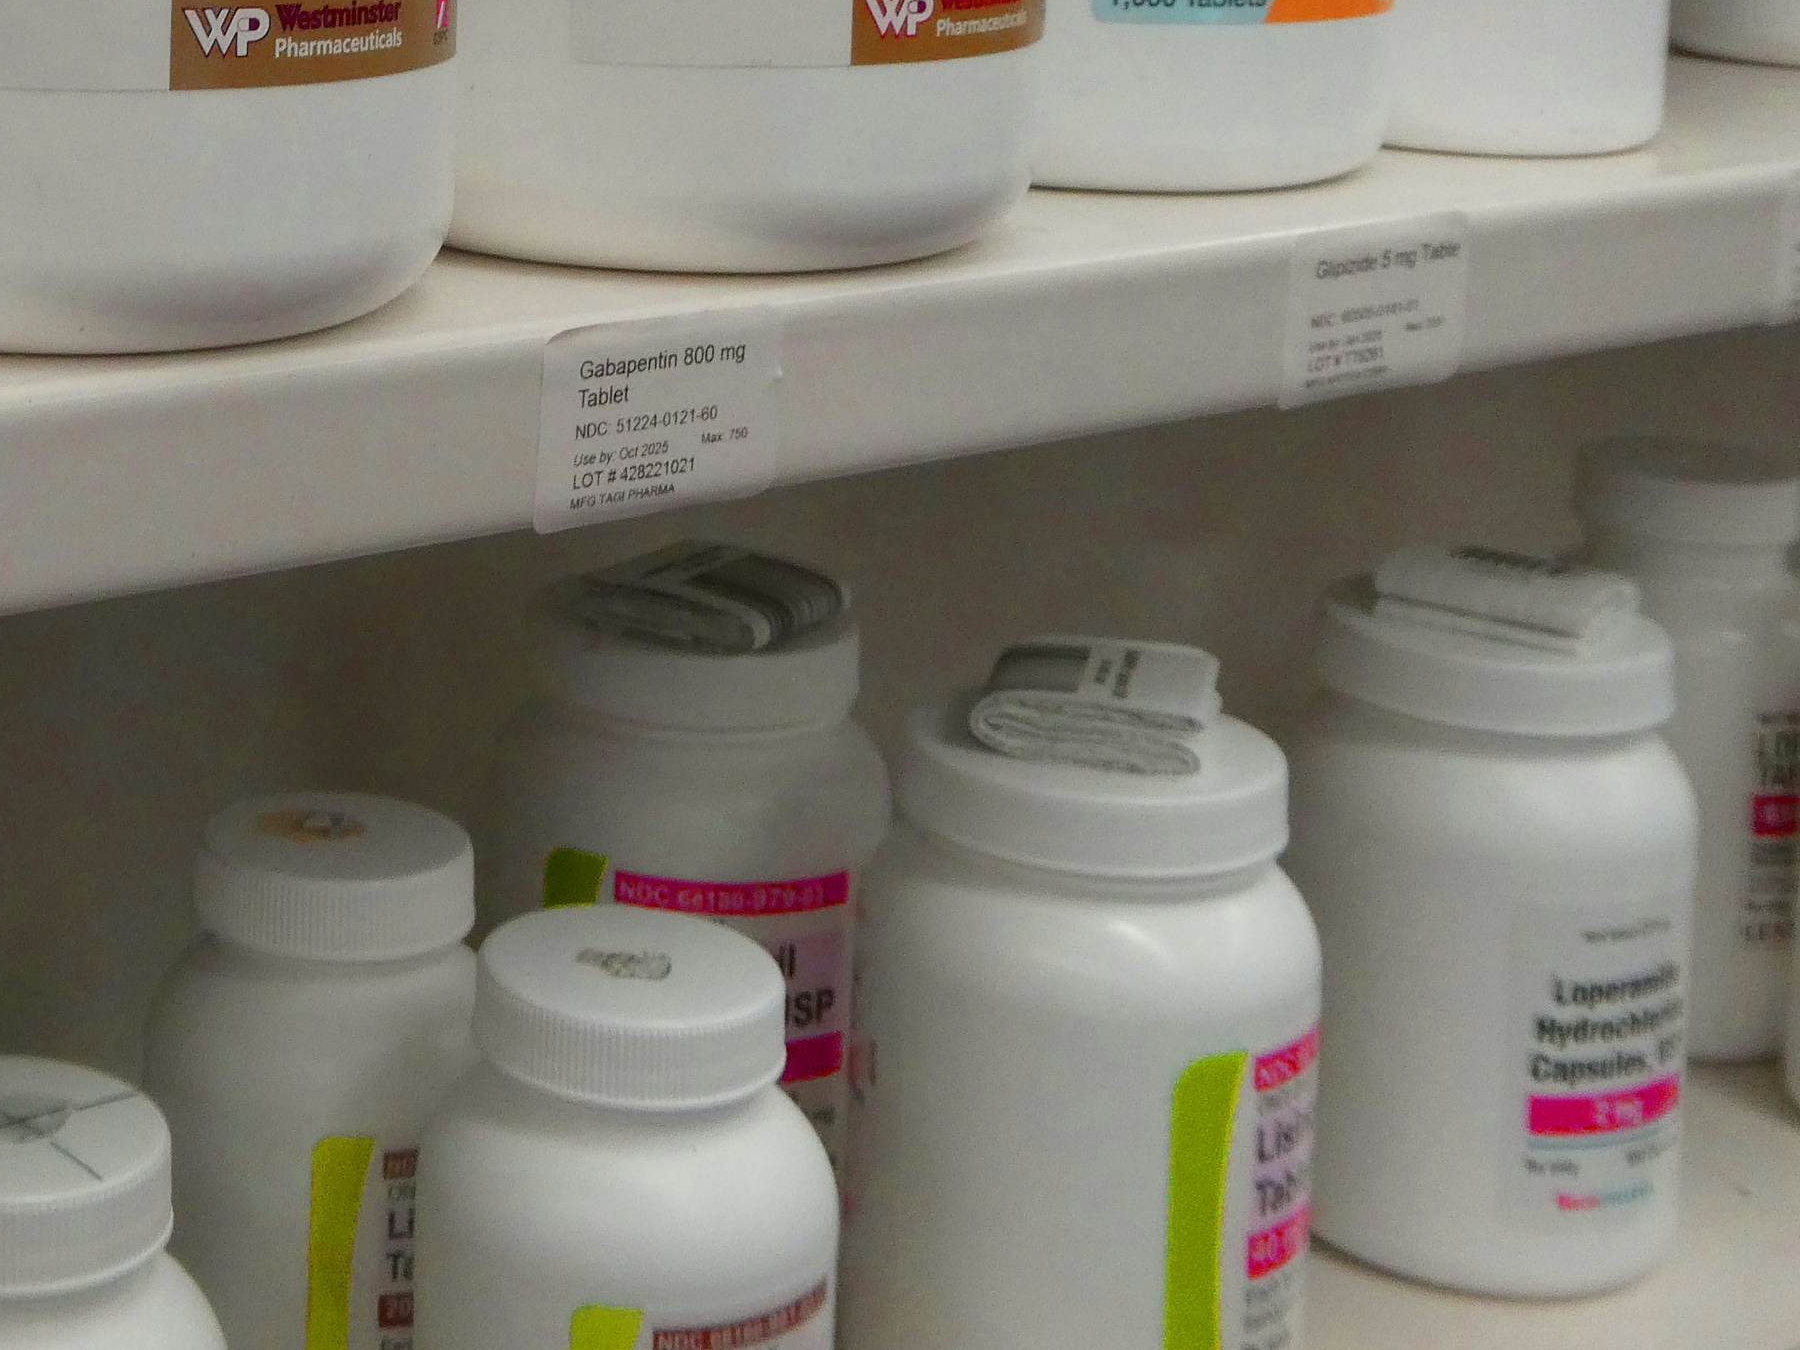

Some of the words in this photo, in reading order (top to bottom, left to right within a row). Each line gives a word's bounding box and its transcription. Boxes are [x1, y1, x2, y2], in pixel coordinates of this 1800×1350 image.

[181, 5, 272, 59] WP
[274, 0, 402, 32] Westminster
[273, 27, 403, 60] Pharmaceuticals
[579, 349, 678, 380] Gabapentin
[683, 343, 716, 367] 800
[719, 343, 747, 365] mg
[577, 383, 630, 409] Tablet
[616, 405, 719, 434] 51224-0121-60
[572, 470, 603, 491] LOT
[619, 456, 696, 482] 428221021
[627, 483, 676, 503] PHARMA
